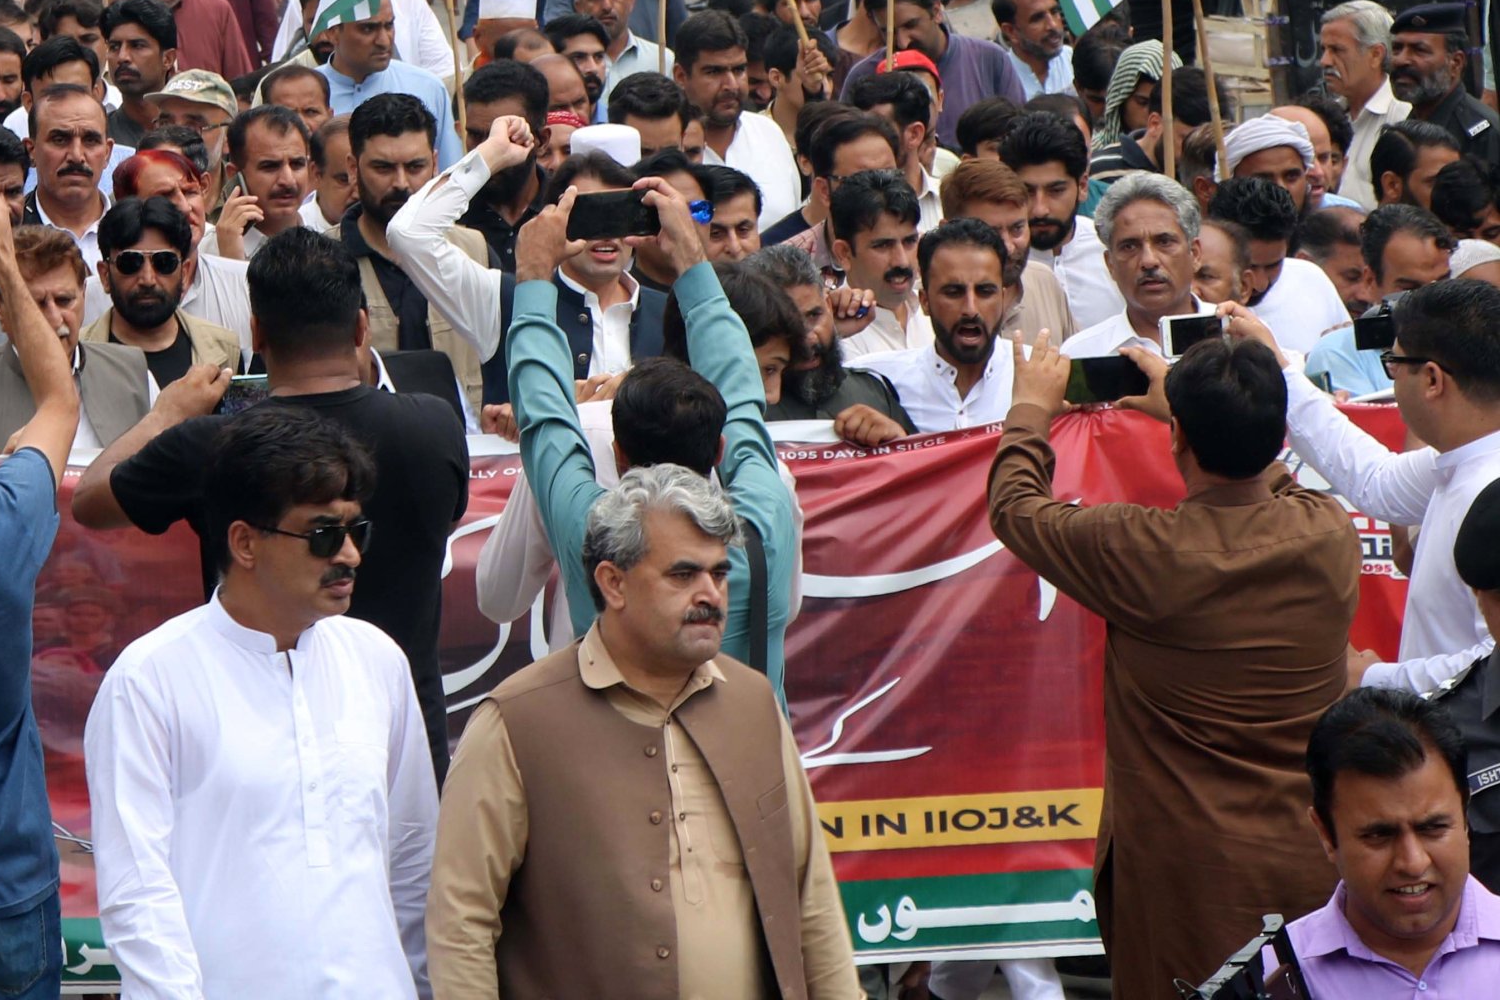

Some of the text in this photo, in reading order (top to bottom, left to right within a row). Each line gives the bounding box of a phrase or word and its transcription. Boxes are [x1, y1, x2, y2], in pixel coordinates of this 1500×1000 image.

[778, 436, 947, 461] 1095 DAYS IN SIEGE
[861, 803, 1083, 837] IN IIOJ&K
